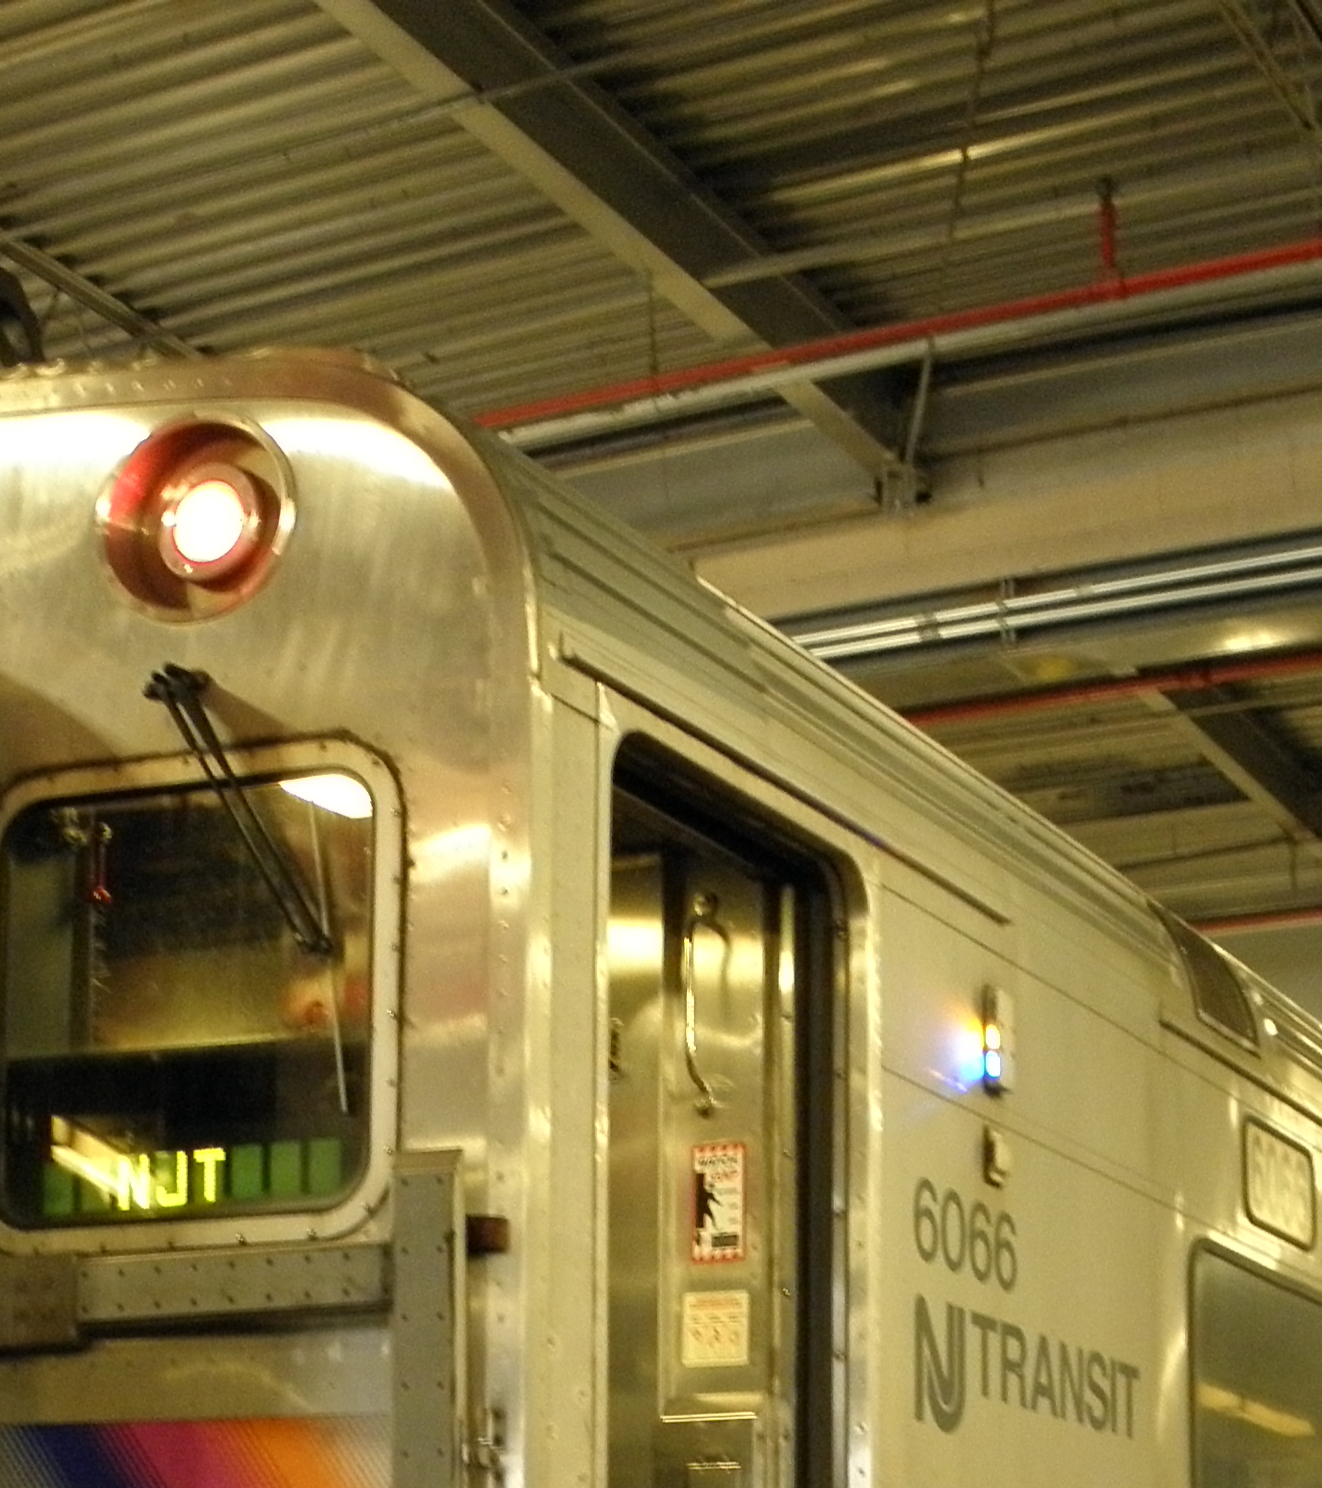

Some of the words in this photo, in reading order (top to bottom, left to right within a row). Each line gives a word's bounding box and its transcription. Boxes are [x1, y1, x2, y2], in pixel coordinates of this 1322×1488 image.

[118, 1148, 226, 1211] NJT
[913, 1176, 1017, 1292] 6066
[970, 1309, 1141, 1440] TRANSIT
